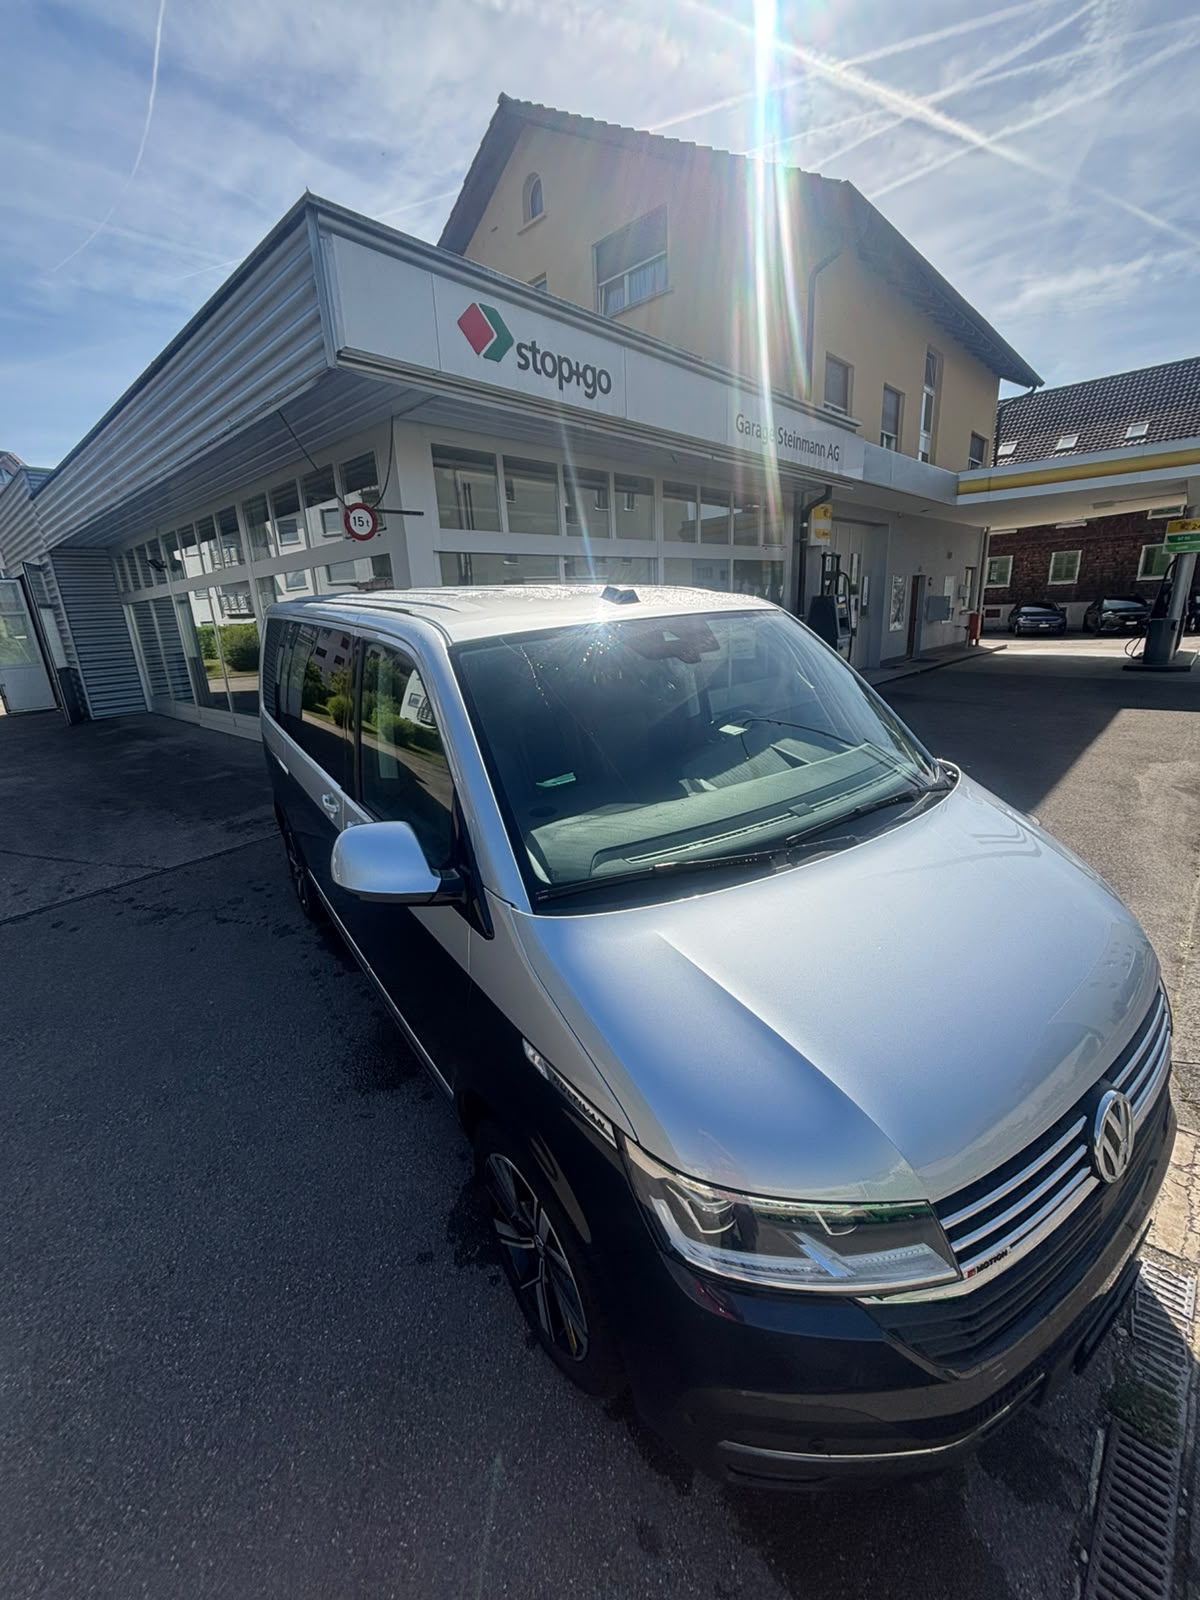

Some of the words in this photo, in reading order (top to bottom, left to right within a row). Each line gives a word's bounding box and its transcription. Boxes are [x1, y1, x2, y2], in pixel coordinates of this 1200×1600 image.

[516, 340, 612, 399] stop+go
[736, 413, 775, 445] Garage
[777, 427, 826, 457] Steinmann
[826, 443, 840, 462] AG
[353, 516, 365, 527] 15
